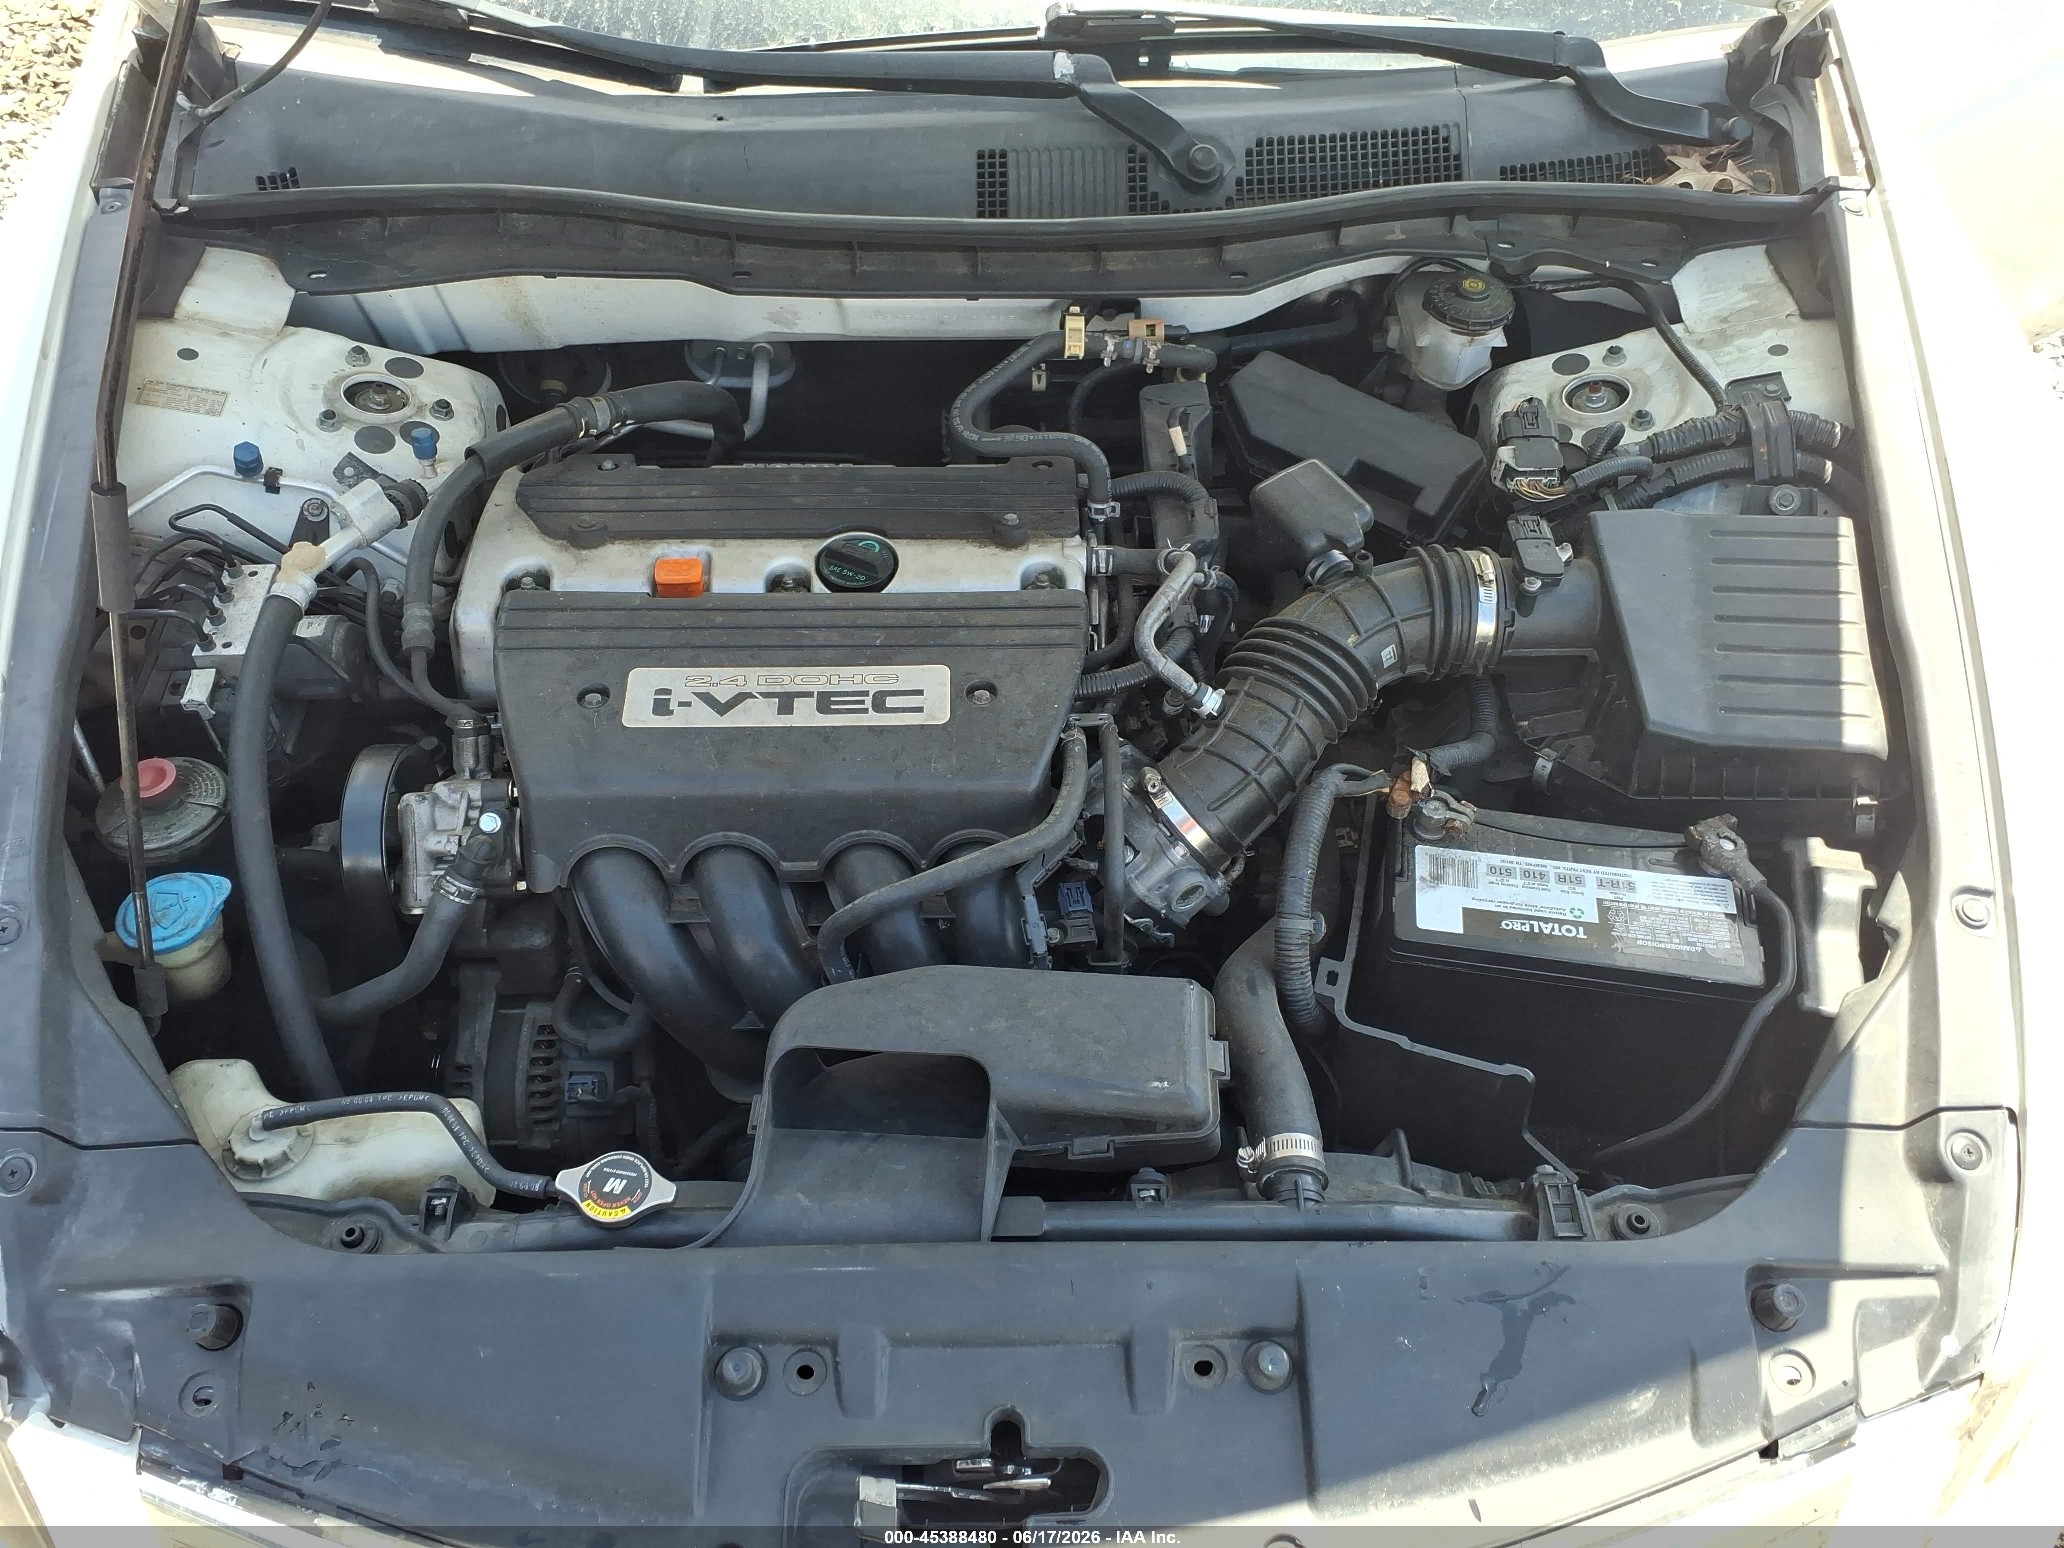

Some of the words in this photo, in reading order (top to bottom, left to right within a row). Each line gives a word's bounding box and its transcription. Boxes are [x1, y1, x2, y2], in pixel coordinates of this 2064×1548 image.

[828, 564, 842, 573] SAE
[842, 569, 866, 581] 5W-20
[684, 674, 748, 687] 2.4
[757, 673, 900, 686] DOHC
[650, 687, 925, 718] i-VTEC
[1489, 866, 1512, 877] 510
[1523, 870, 1546, 881] 410
[1556, 874, 1583, 885] 51R
[1597, 878, 1635, 891] 51R-T
[612, 1196, 632, 1208] NEVER
[586, 1202, 618, 1216] CAUTION
